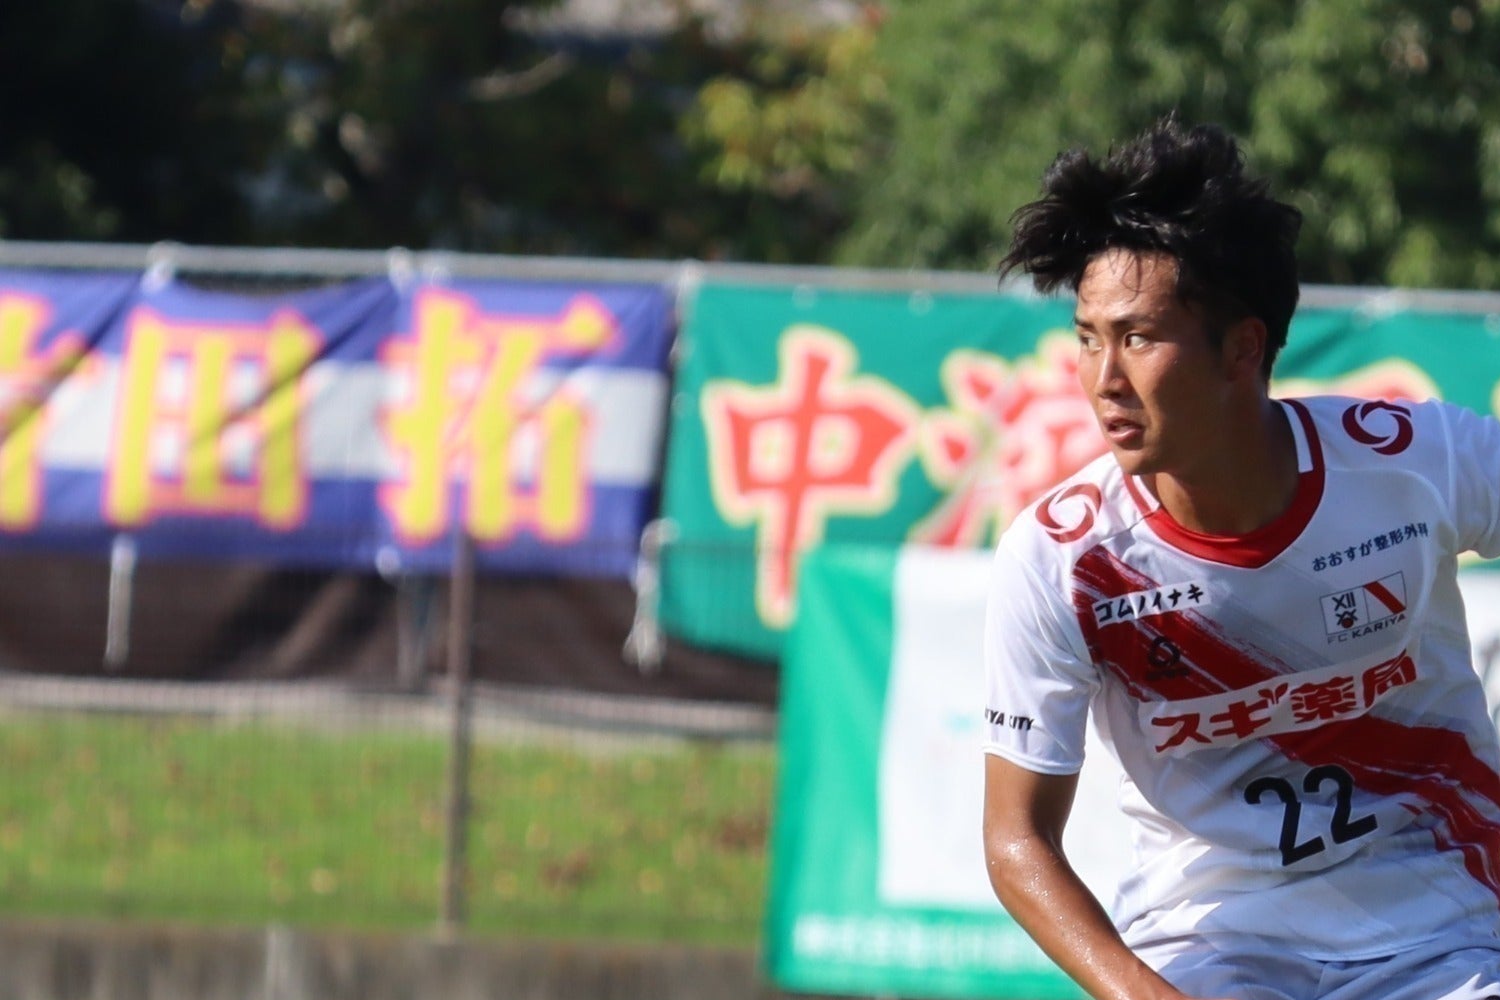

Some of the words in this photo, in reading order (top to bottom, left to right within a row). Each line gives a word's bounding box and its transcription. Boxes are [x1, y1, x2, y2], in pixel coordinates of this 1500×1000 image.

[1312, 522, 1429, 572] おおすが整形外科
[1095, 583, 1205, 623] ゴムノイナキ
[1327, 632, 1349, 645] FC
[1351, 613, 1406, 639] KARIYA
[1151, 649, 1417, 753] スギ薬局
[1243, 764, 1378, 867] 22
